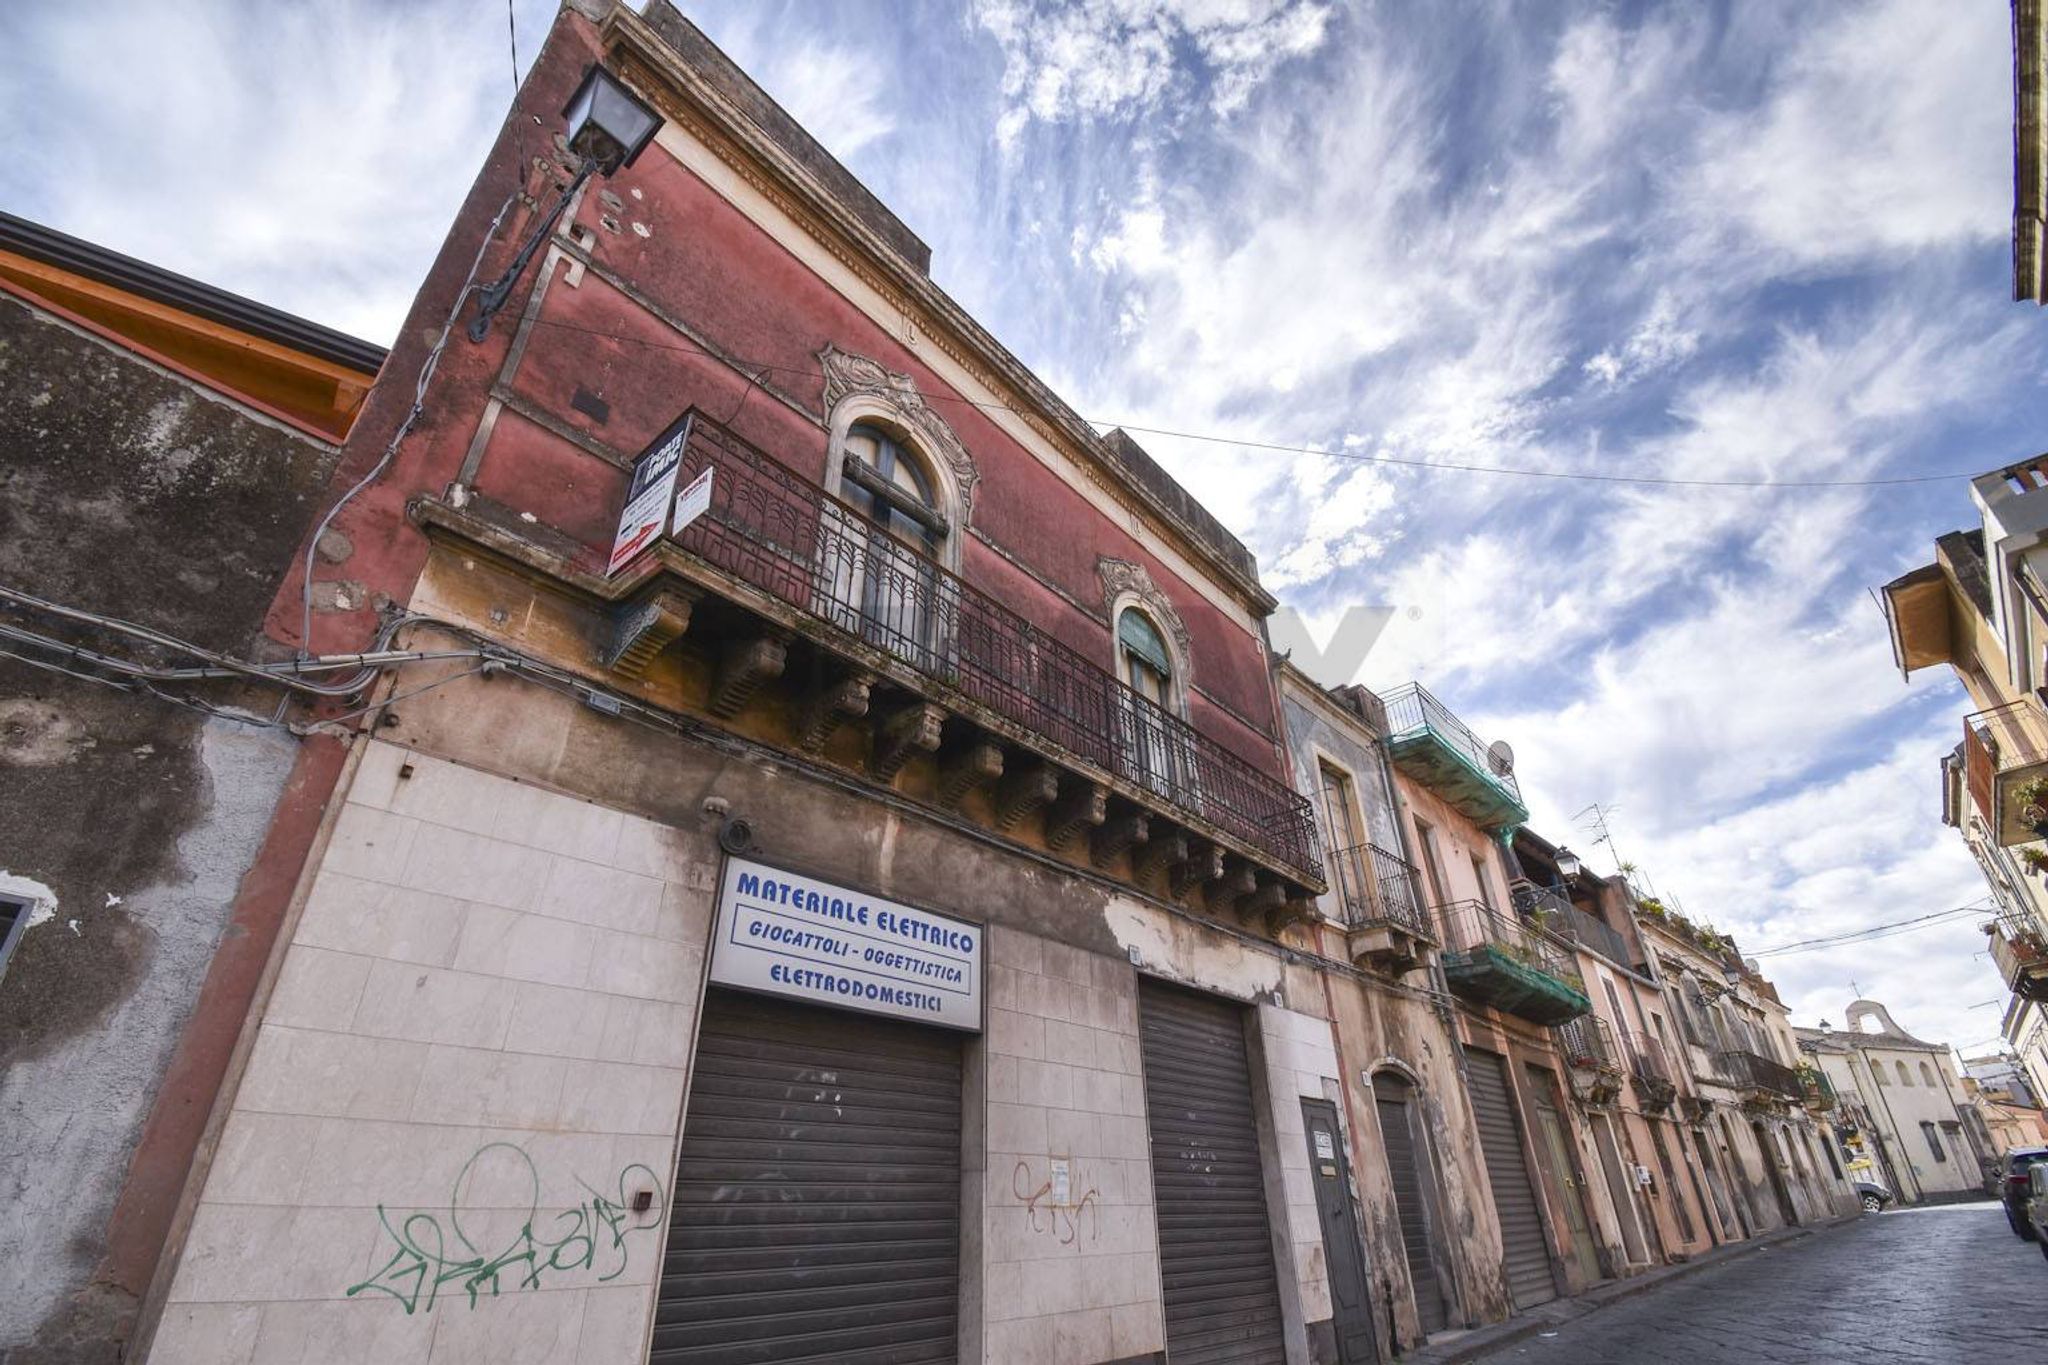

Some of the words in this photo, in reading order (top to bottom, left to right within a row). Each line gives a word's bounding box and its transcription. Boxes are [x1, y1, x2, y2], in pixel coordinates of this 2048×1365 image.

[736, 871, 869, 926] MATERIALE
[876, 911, 974, 954] ELETTRICO
[748, 920, 848, 957] GIOCATTOLI
[863, 947, 961, 983] OGGETTISTICA
[769, 963, 942, 1012] ELETTRODOMESTICI
